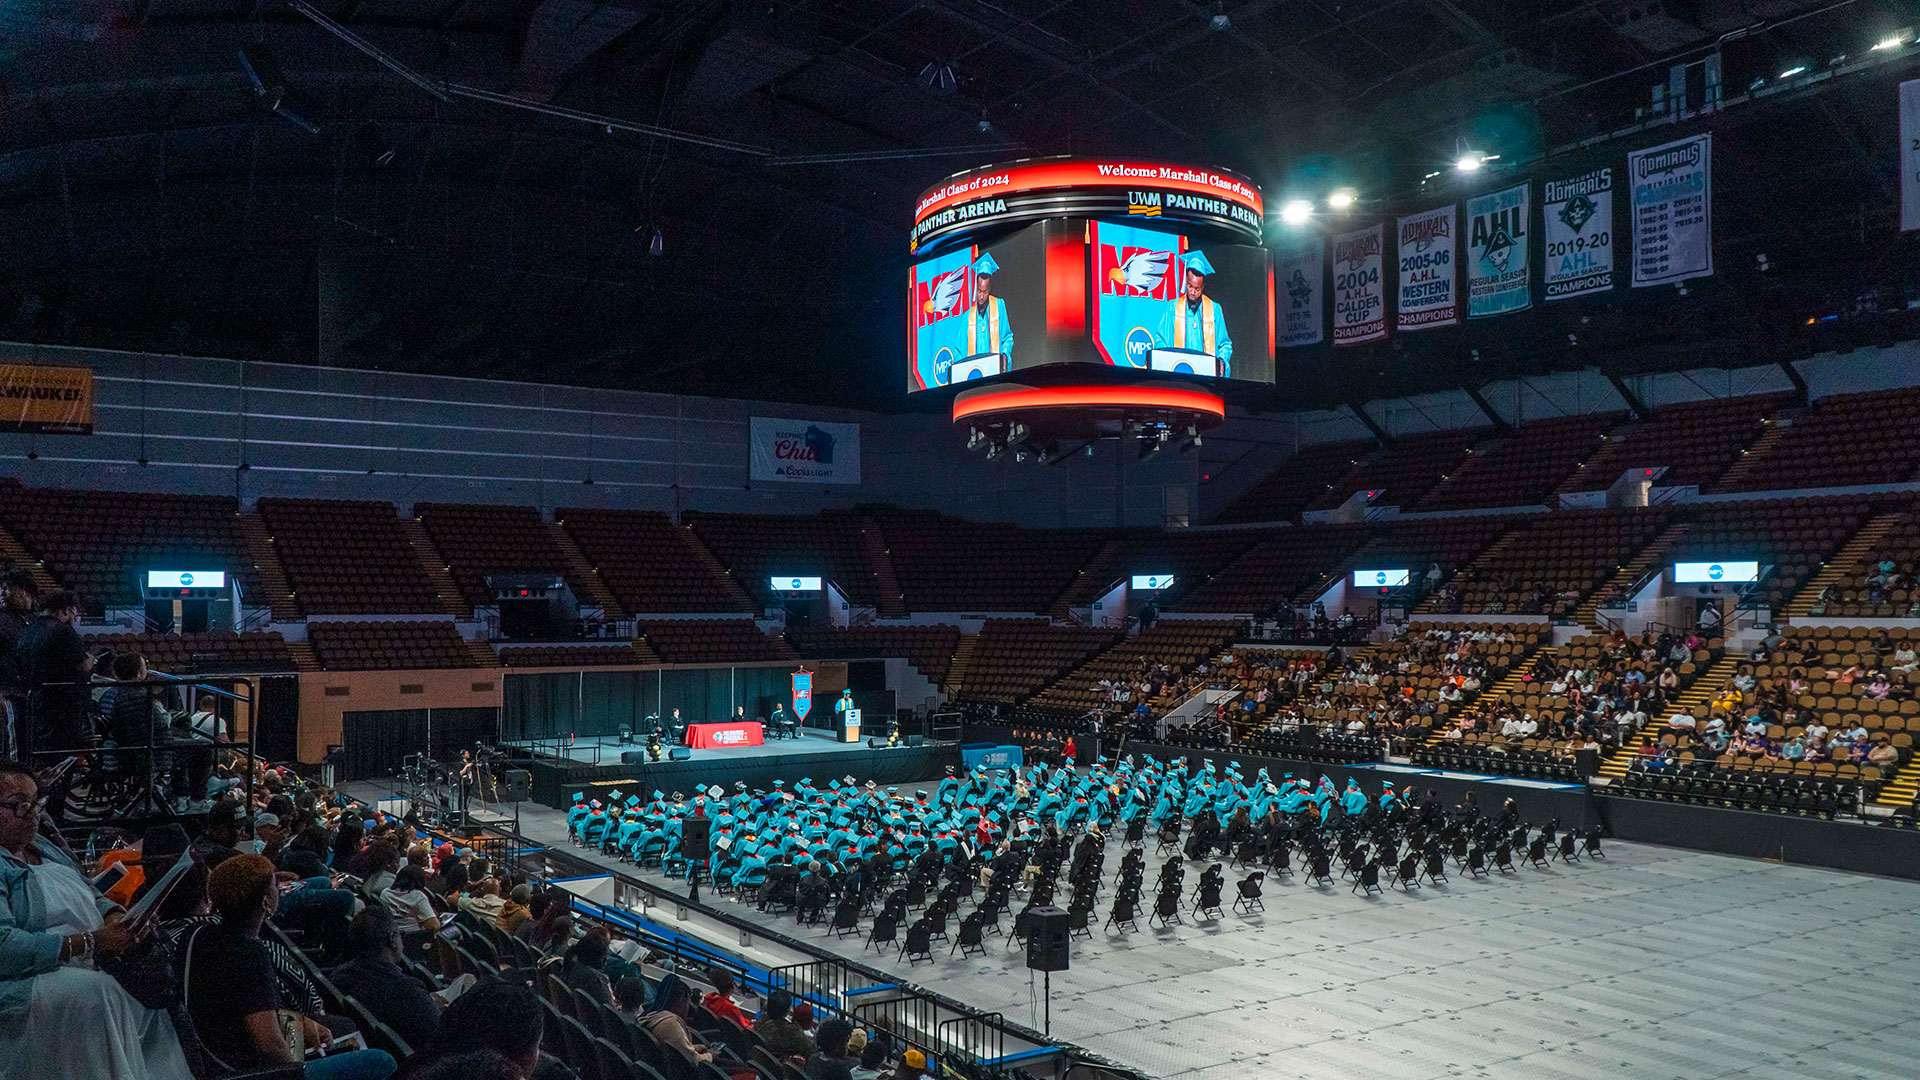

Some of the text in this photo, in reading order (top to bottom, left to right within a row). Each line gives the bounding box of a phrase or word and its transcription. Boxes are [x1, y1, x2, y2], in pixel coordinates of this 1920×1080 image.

[1640, 144, 1699, 178] ADMIRALS
[947, 184, 968, 197] Class
[969, 178, 981, 189] of
[982, 175, 1009, 188] 2024
[1098, 165, 1254, 203] Welcome Marshall Class of 2024
[1545, 168, 1612, 203] ADMIRALS
[1648, 174, 1692, 190] DIVISION
[918, 209, 956, 236] PANTHER
[959, 199, 1007, 220] ARENA
[1128, 191, 1259, 228] UWM PANTHER ARENA
[1402, 215, 1450, 247] ADMIRALS
[1471, 206, 1525, 248] AHL
[1548, 232, 1609, 258] 2019-20
[1401, 250, 1450, 272] 2005-06
[1560, 252, 1597, 273] AHL
[1337, 267, 1379, 291] 2004
[1410, 269, 1440, 284] A.H.L.
[1471, 267, 1527, 287] REGULAR SEASON
[1551, 265, 1608, 280] REGULAR SEASON
[1345, 287, 1372, 301] A.H.L.
[1402, 279, 1450, 298] WESTERN
[1547, 274, 1611, 295] CHAMPIONS
[1337, 295, 1380, 314] CALDER
[1402, 293, 1449, 308] CONFERENCE
[1345, 309, 1369, 323] CUP
[1399, 308, 1454, 325] CHAMPIONS
[1334, 320, 1384, 338] CHAMPIONS
